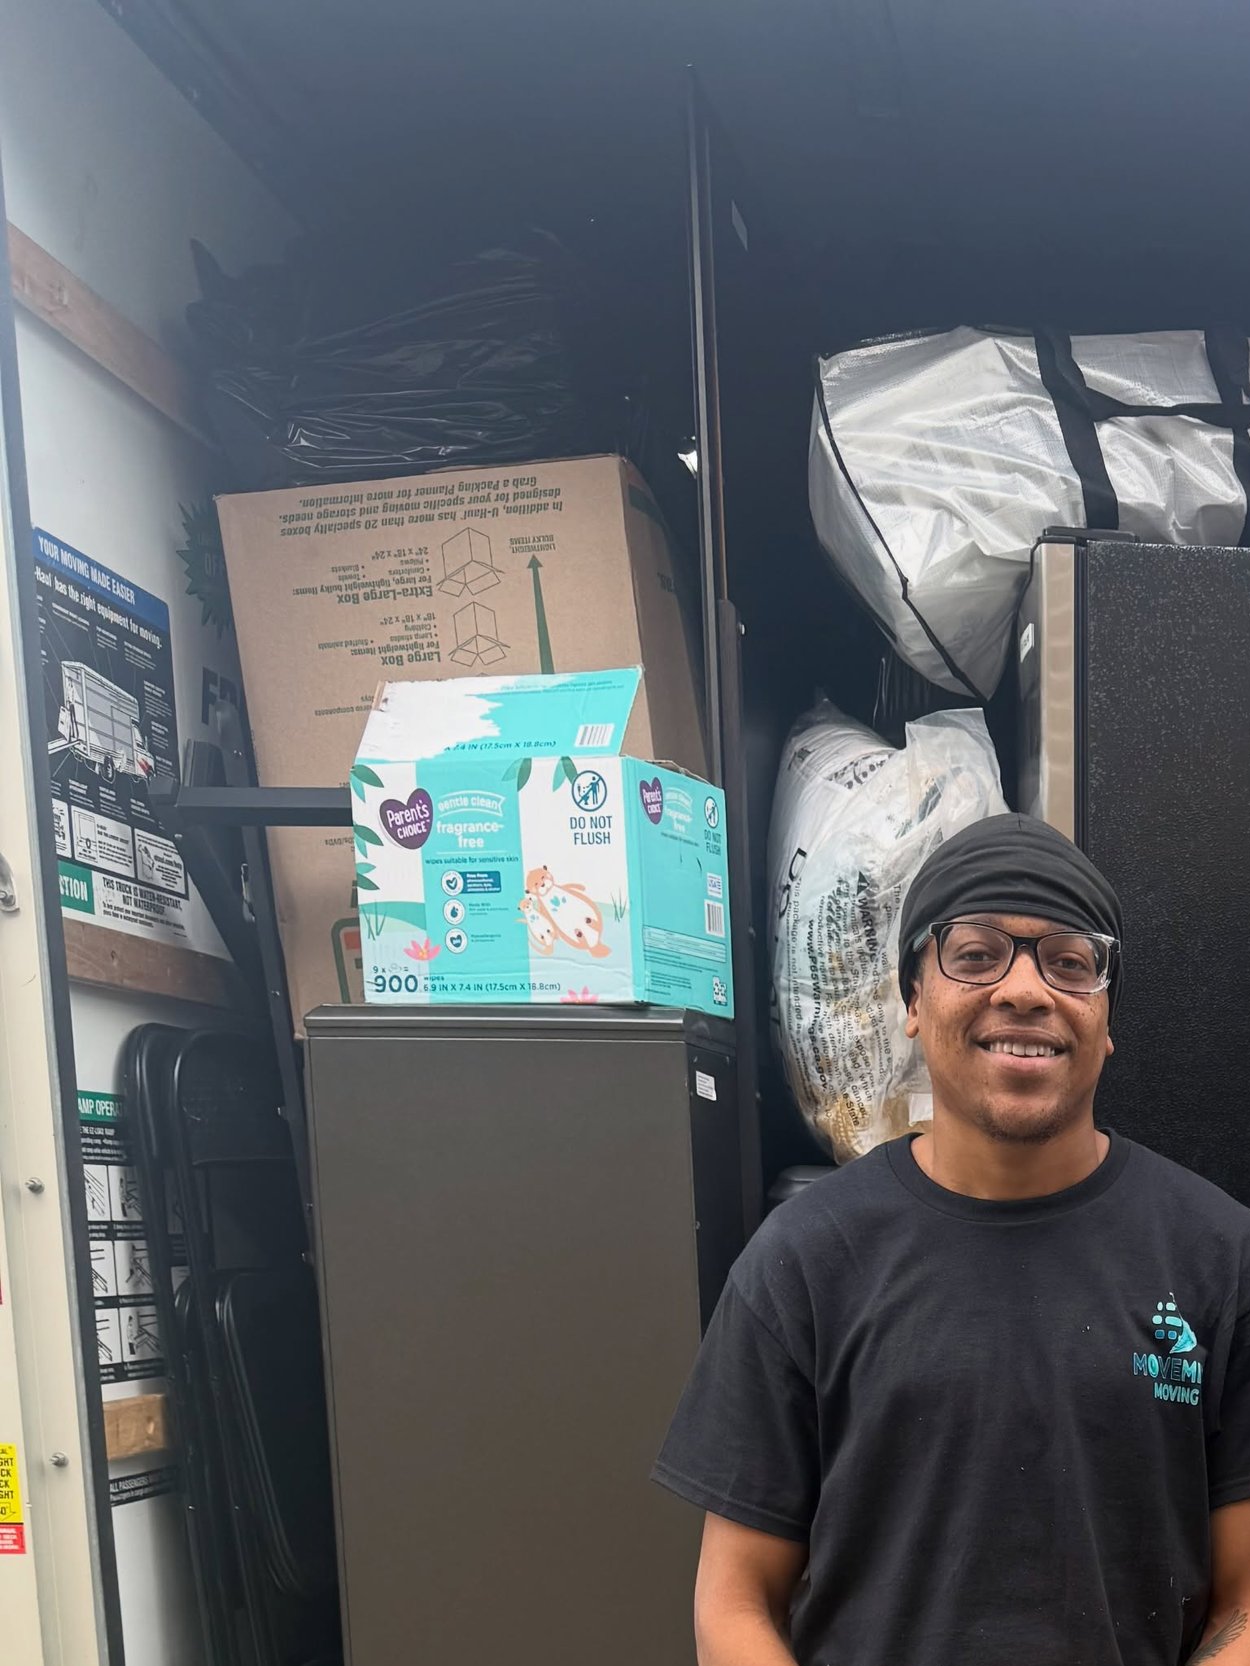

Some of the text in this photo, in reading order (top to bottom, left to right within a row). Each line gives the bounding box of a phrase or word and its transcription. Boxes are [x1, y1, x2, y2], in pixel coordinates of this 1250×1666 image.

[458, 480, 500, 492] Packing
[512, 476, 537, 487] Grab
[367, 491, 393, 501] more
[397, 489, 411, 499] for
[415, 484, 455, 495] Planner
[280, 488, 561, 523] designed for your specific moving and storage needs.
[300, 494, 363, 508] information.
[553, 501, 563, 511] In
[503, 503, 549, 515] addition,
[382, 516, 404, 527] than
[409, 513, 435, 524] more
[438, 511, 456, 521] has
[314, 520, 361, 534] specialty
[365, 519, 378, 530] 20
[280, 526, 310, 537] boxes
[38, 536, 136, 605] YOUR MOVING MADE EASIER
[338, 586, 433, 604] Extra-Large Box
[54, 576, 68, 595] has
[68, 584, 80, 602] the
[80, 592, 97, 612] right
[97, 603, 130, 630] equipment
[130, 618, 139, 634] for
[140, 627, 162, 649] moving.
[381, 650, 441, 666] Large Box
[438, 796, 469, 811] gentle
[386, 800, 430, 828] Parent's
[436, 821, 504, 836] fragrance-
[570, 816, 613, 829] DO NOT
[397, 820, 427, 839] CHOICE
[458, 836, 485, 848] free
[574, 832, 611, 845] FLUSH
[102, 876, 115, 890] THIS
[116, 880, 132, 895] TRUCK
[374, 974, 419, 993] 900
[486, 982, 517, 992] (17.5cm
[78, 1097, 94, 1114] AMP
[1154, 1382, 1200, 1406] MOVING
